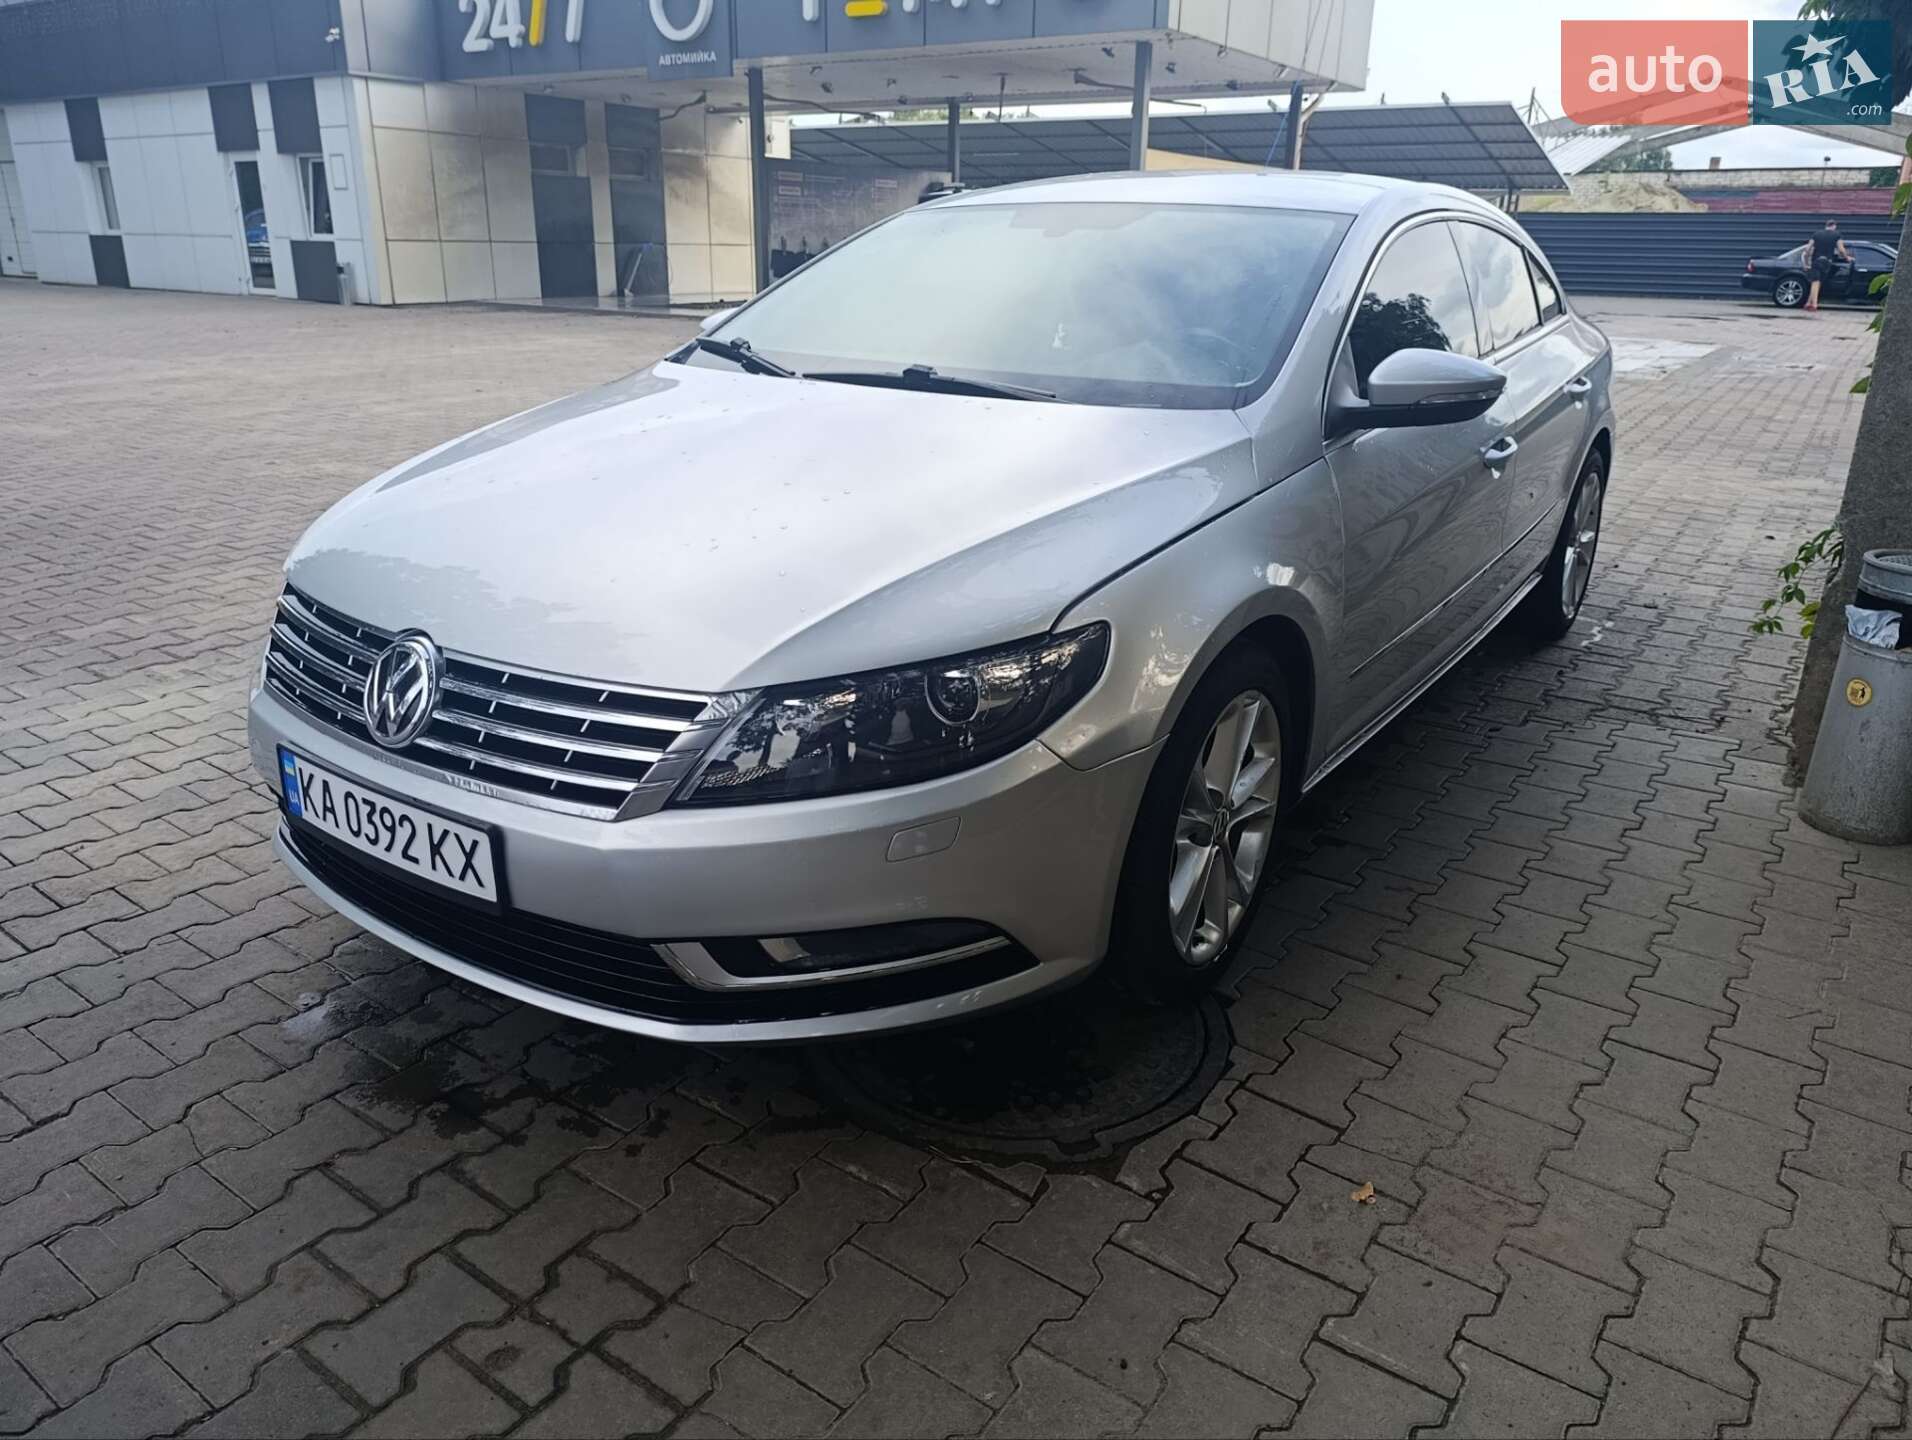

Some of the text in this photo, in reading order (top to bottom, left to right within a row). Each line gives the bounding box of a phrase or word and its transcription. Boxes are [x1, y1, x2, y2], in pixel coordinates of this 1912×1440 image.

[658, 50, 717, 66] АВТОМИЙКА
[298, 767, 486, 888] KA 0392 KX
